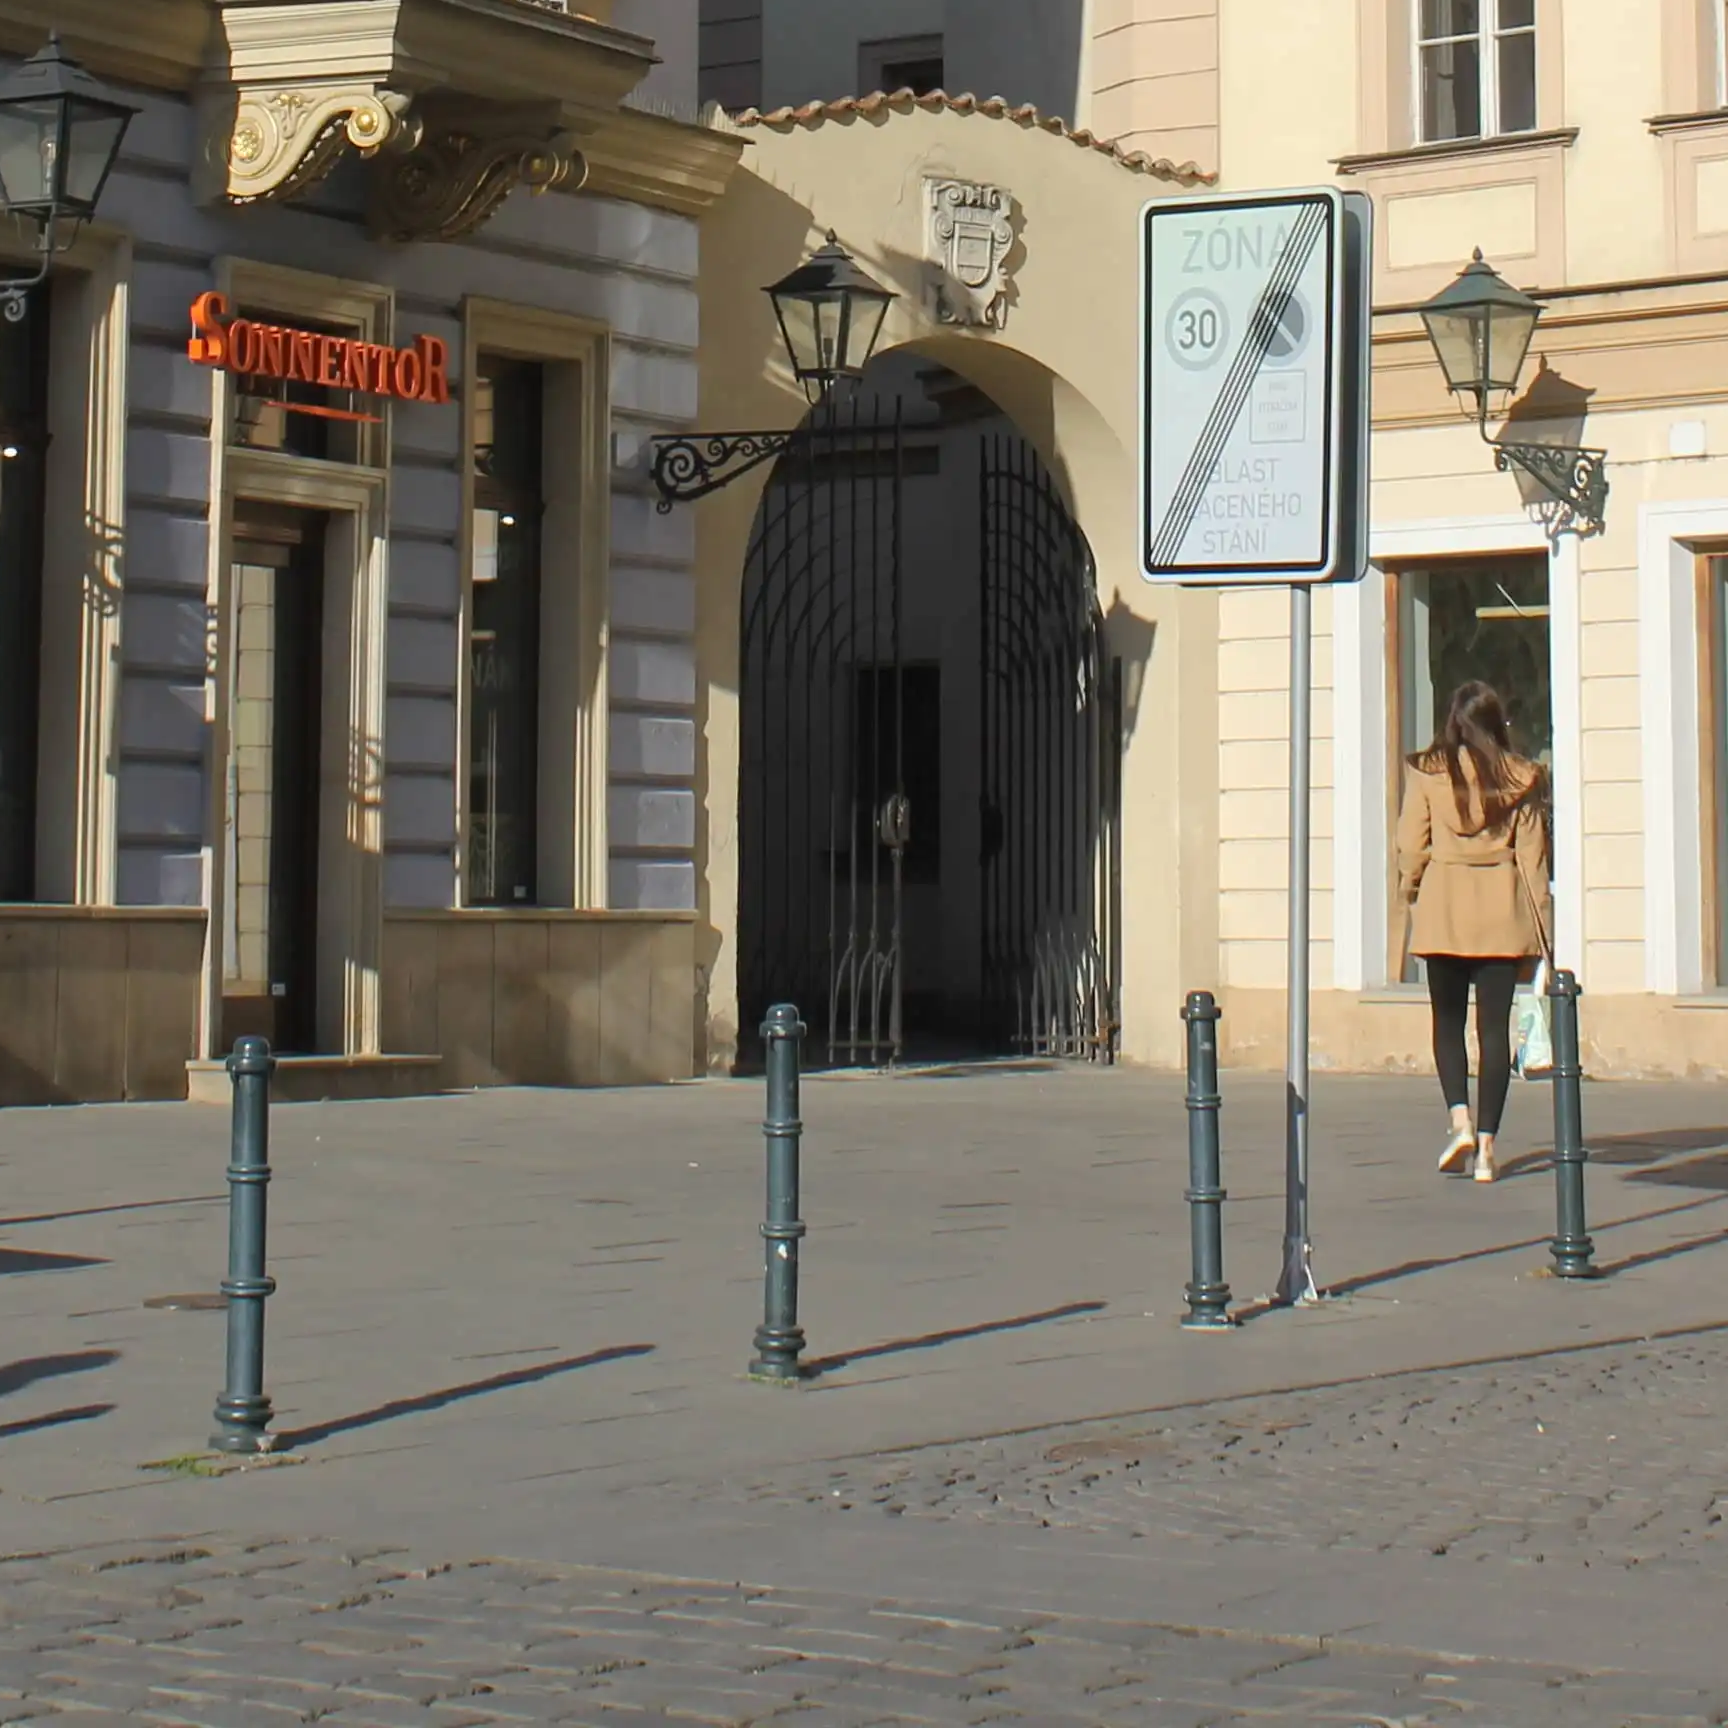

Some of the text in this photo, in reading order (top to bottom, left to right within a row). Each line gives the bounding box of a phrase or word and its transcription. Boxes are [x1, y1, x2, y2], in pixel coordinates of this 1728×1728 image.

[1181, 216, 1290, 273] ZÓNA
[189, 291, 450, 404] SONNENTOR
[1178, 308, 1217, 351] 30
[1207, 457, 1282, 485] BLAST
[1193, 487, 1303, 521] ACENÉHO
[1202, 522, 1270, 555] STÁNÍ
